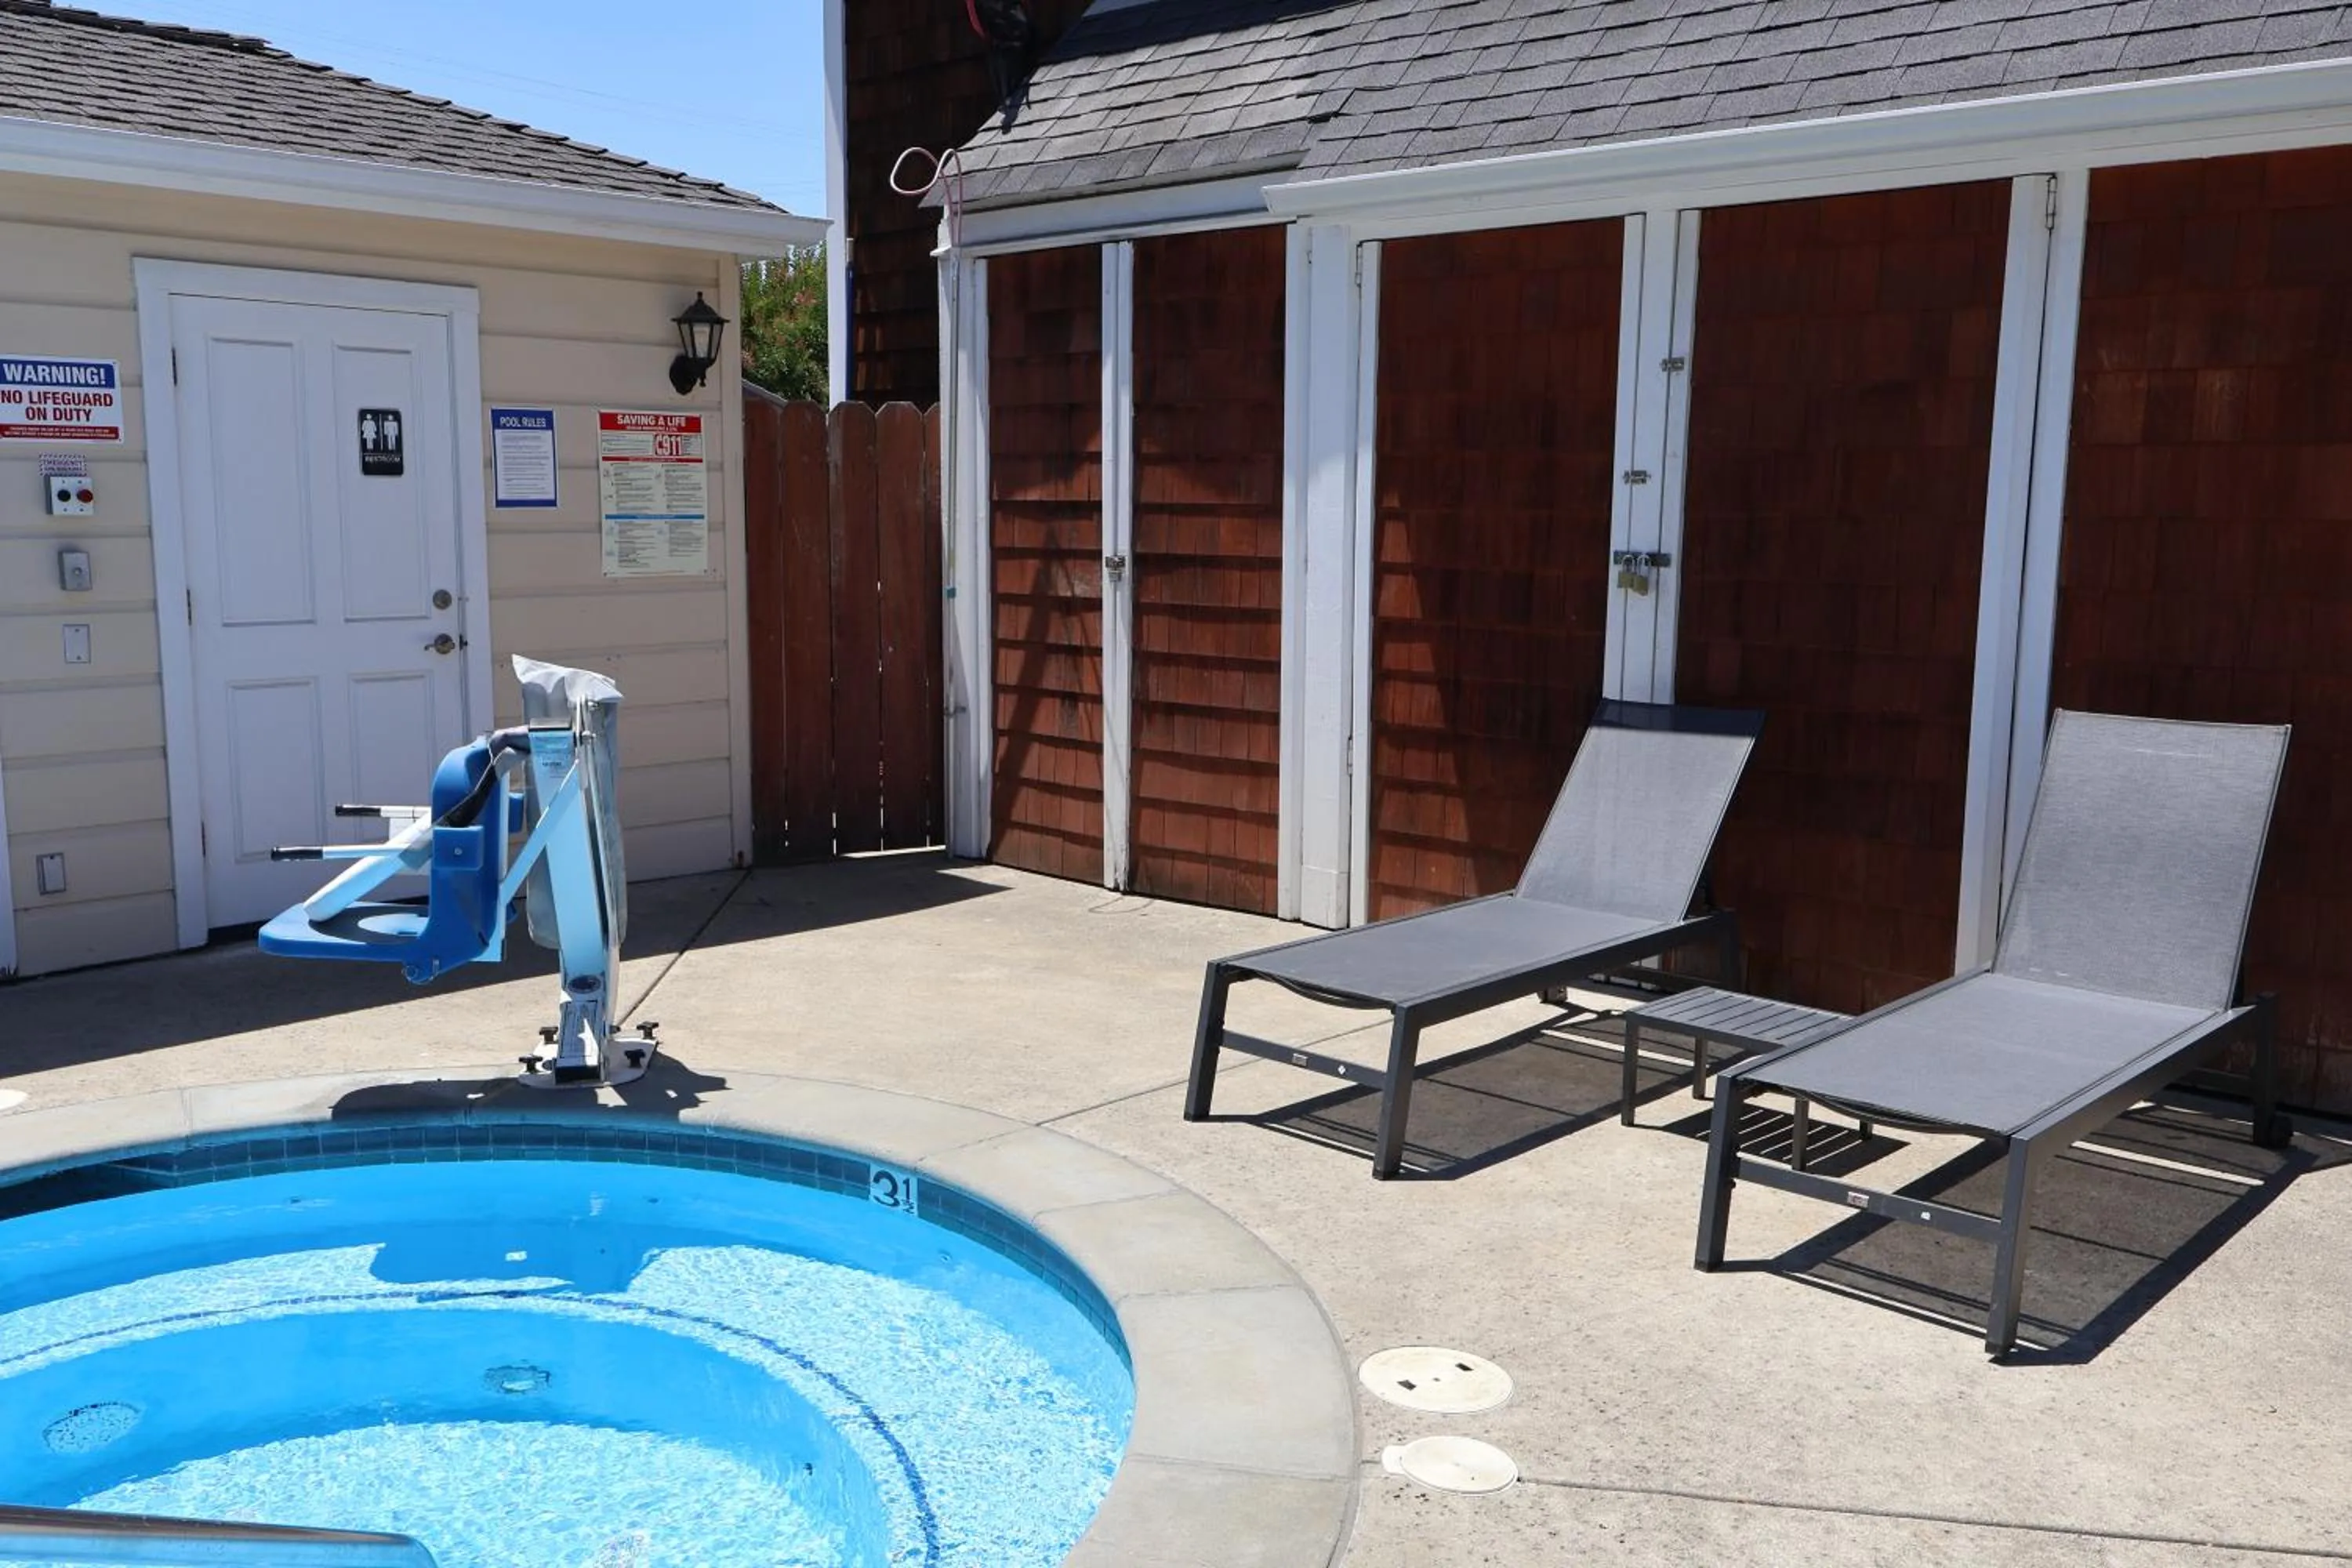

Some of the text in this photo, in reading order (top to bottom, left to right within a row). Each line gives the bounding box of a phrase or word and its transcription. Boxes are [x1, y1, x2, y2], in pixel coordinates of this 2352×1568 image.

[2, 363, 106, 385] WARNING!
[1, 390, 113, 407] NO LIFEGUARD
[25, 407, 92, 422] ON DUTY
[499, 416, 546, 427] POOL RULES
[616, 414, 687, 427] SAVING A LIFE
[662, 435, 681, 456] 911
